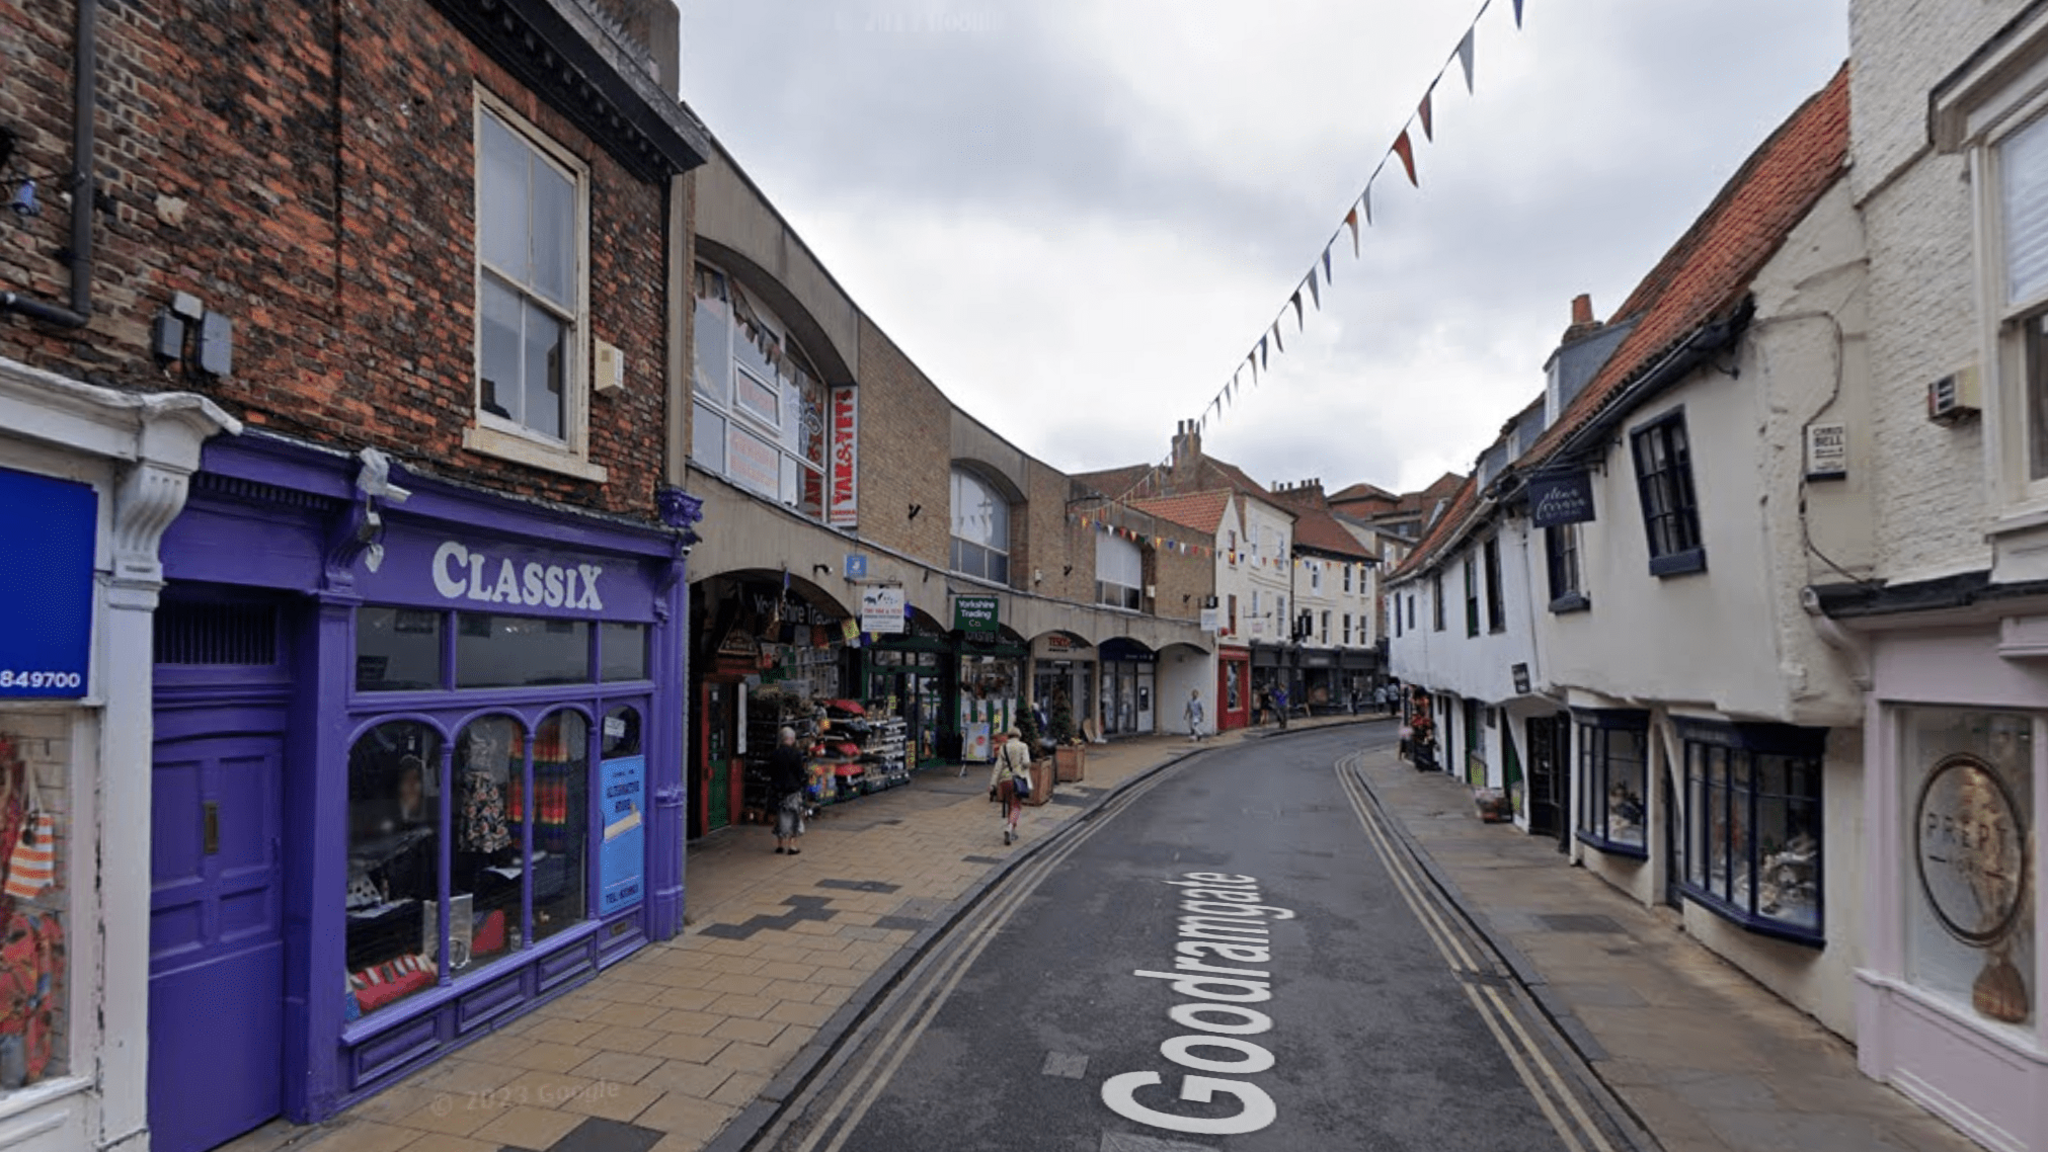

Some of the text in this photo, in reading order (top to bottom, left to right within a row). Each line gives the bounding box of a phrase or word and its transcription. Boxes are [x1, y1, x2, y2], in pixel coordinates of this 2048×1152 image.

[432, 541, 603, 611] CLASSIX
[958, 600, 995, 609] Yorkshire
[961, 609, 991, 620] Trading
[0, 669, 81, 688] 849700
